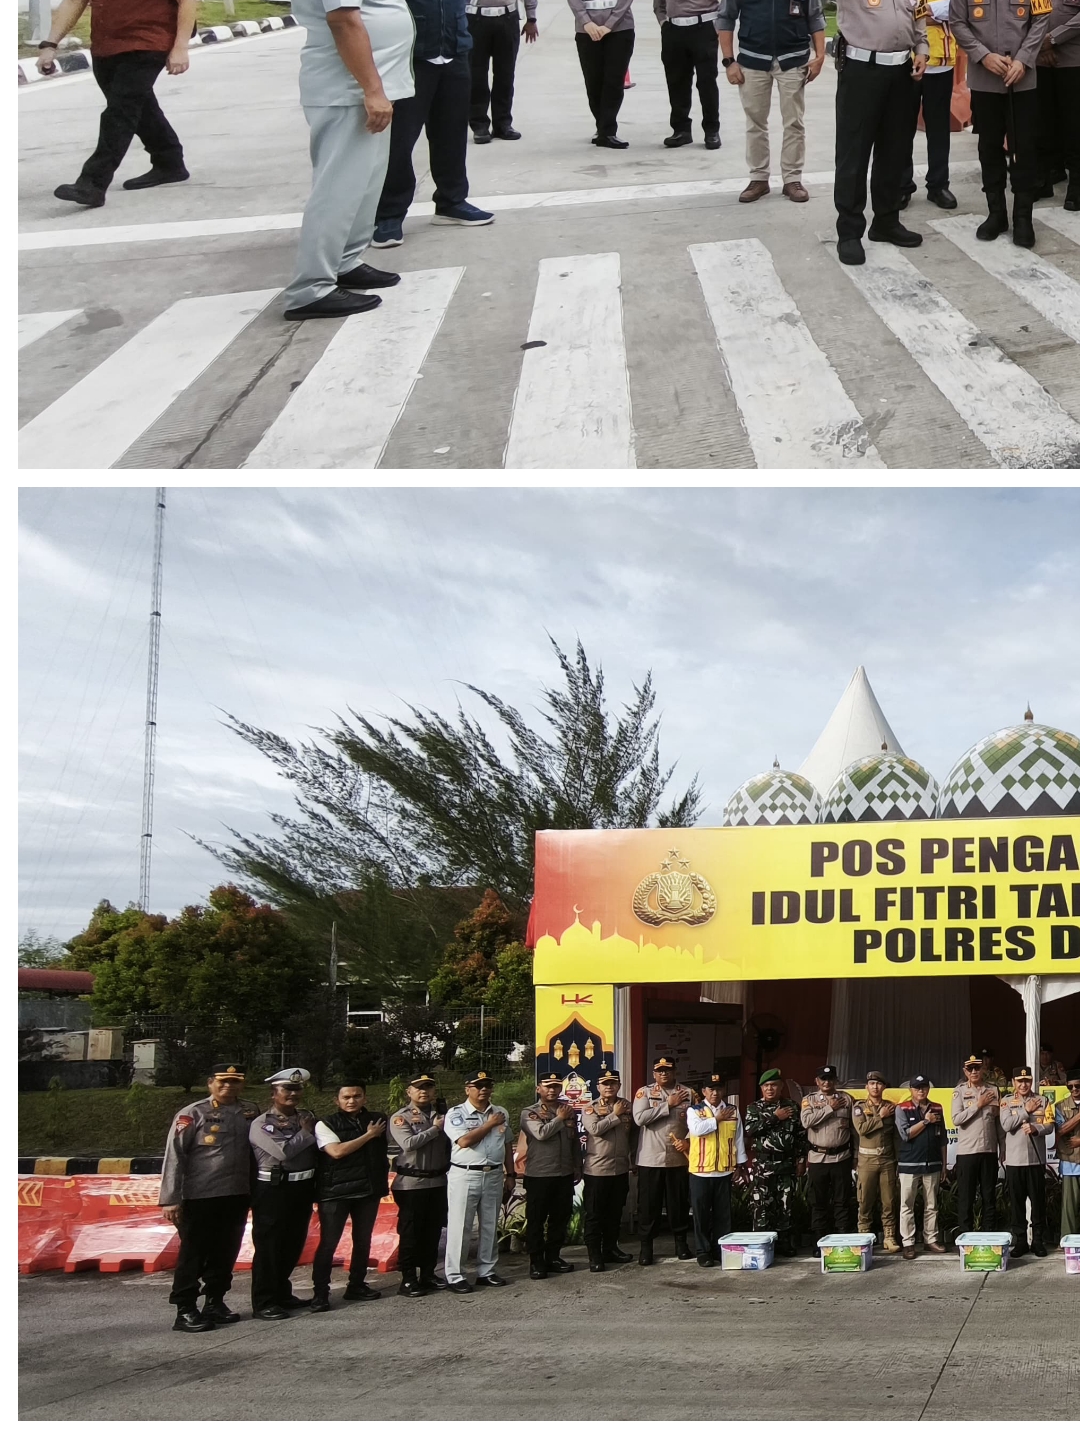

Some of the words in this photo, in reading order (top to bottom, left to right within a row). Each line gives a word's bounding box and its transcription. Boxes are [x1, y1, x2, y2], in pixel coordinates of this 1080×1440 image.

[810, 837, 907, 878] POS
[752, 888, 861, 926] IDUL
[874, 883, 995, 922] FITRI
[853, 925, 1040, 964] POLRES
